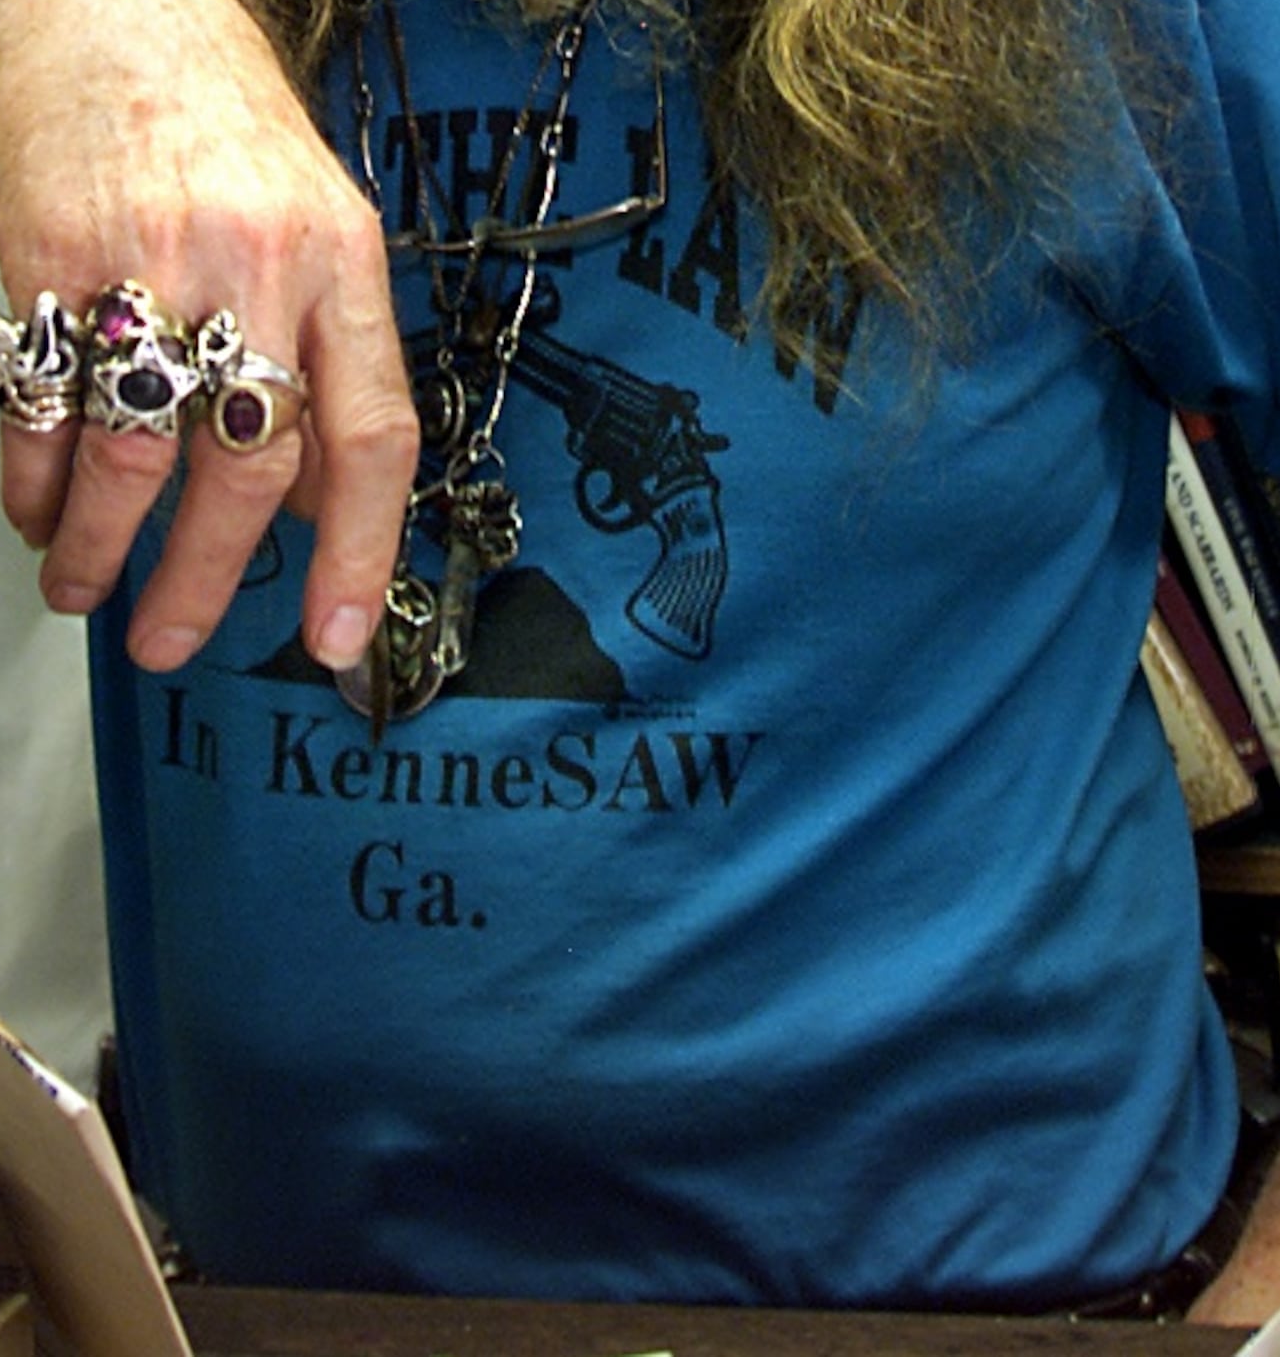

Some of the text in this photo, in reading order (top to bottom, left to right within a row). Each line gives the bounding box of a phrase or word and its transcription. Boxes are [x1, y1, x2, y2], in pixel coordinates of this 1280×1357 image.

[159, 686, 766, 813] In KenneSAW
[349, 840, 488, 931] Ga.
